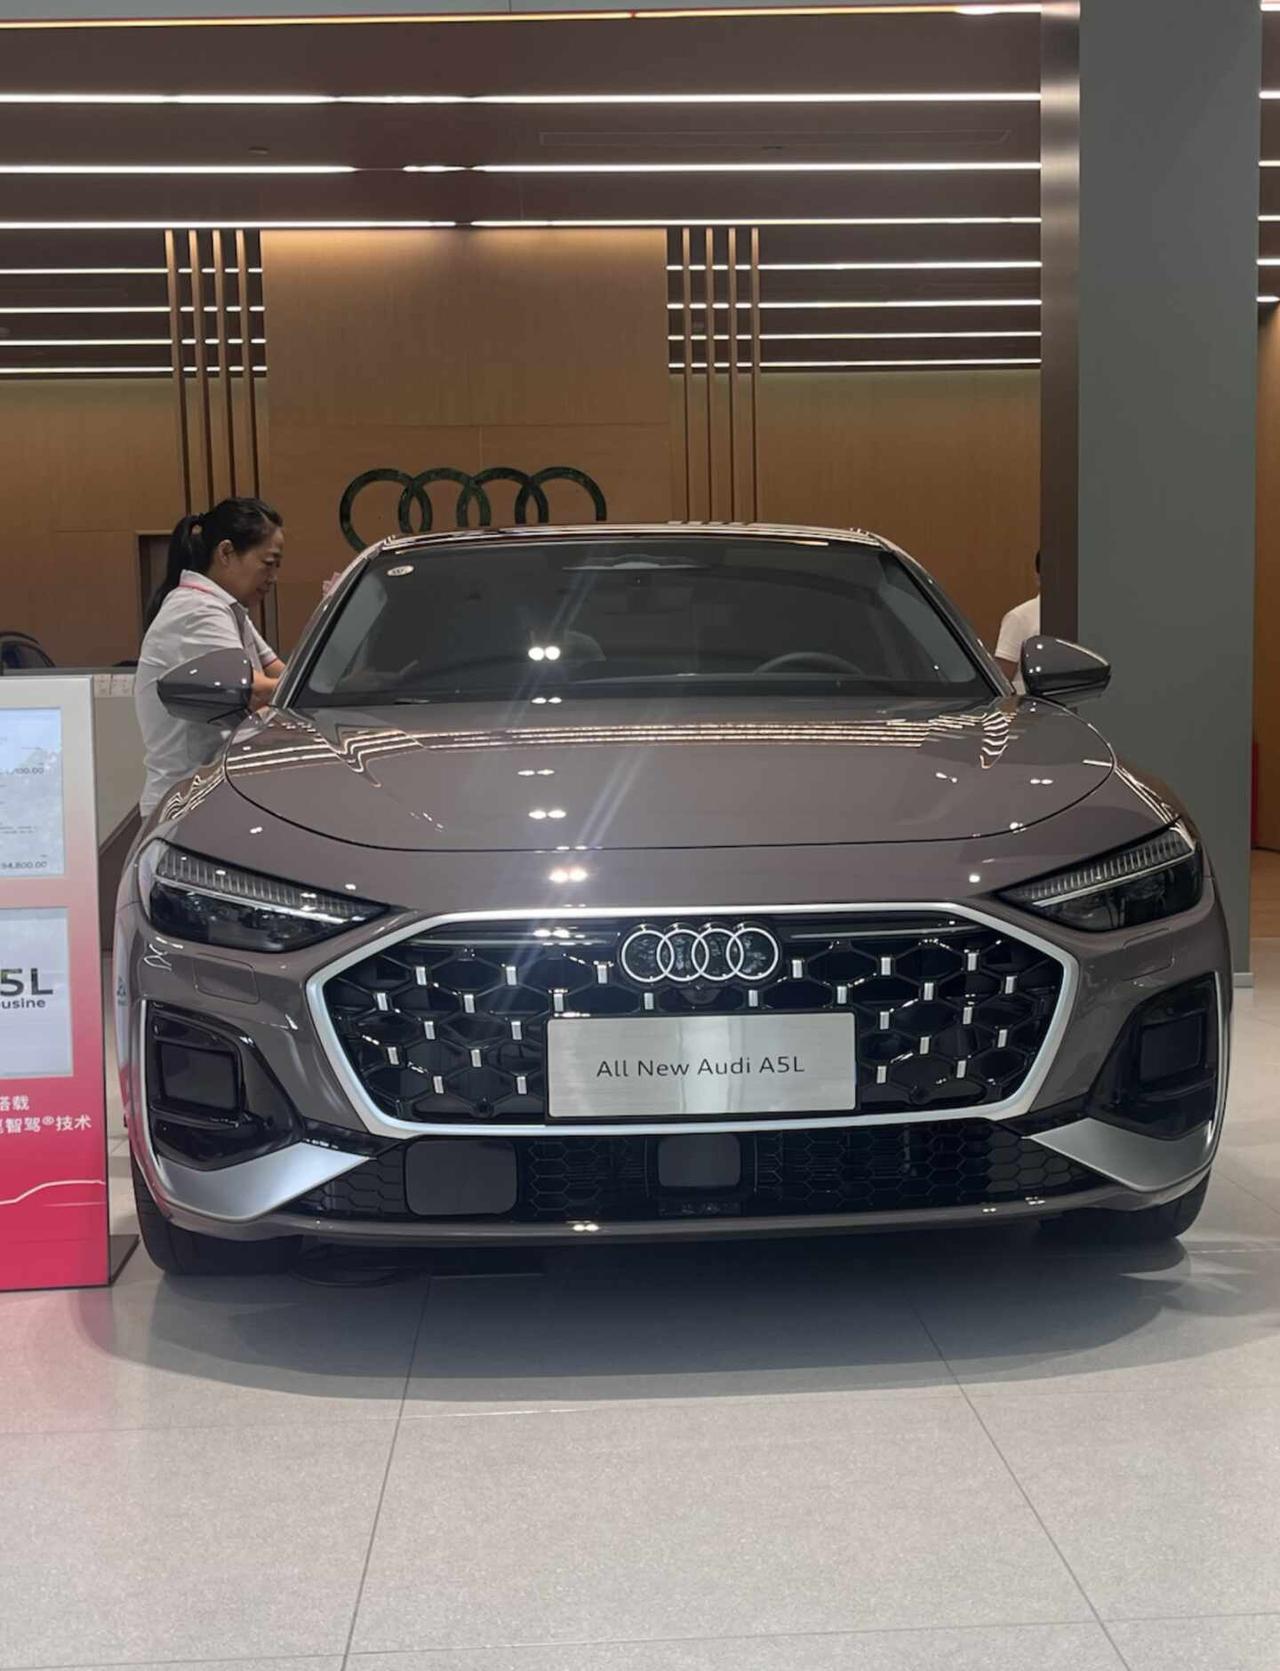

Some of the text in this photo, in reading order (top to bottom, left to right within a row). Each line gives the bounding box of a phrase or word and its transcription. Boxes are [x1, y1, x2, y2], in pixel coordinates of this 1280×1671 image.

[1, 997, 46, 1009] usine
[596, 1055, 806, 1078] All New Audi A5L
[0, 1113, 93, 1134] 智驾®技术
